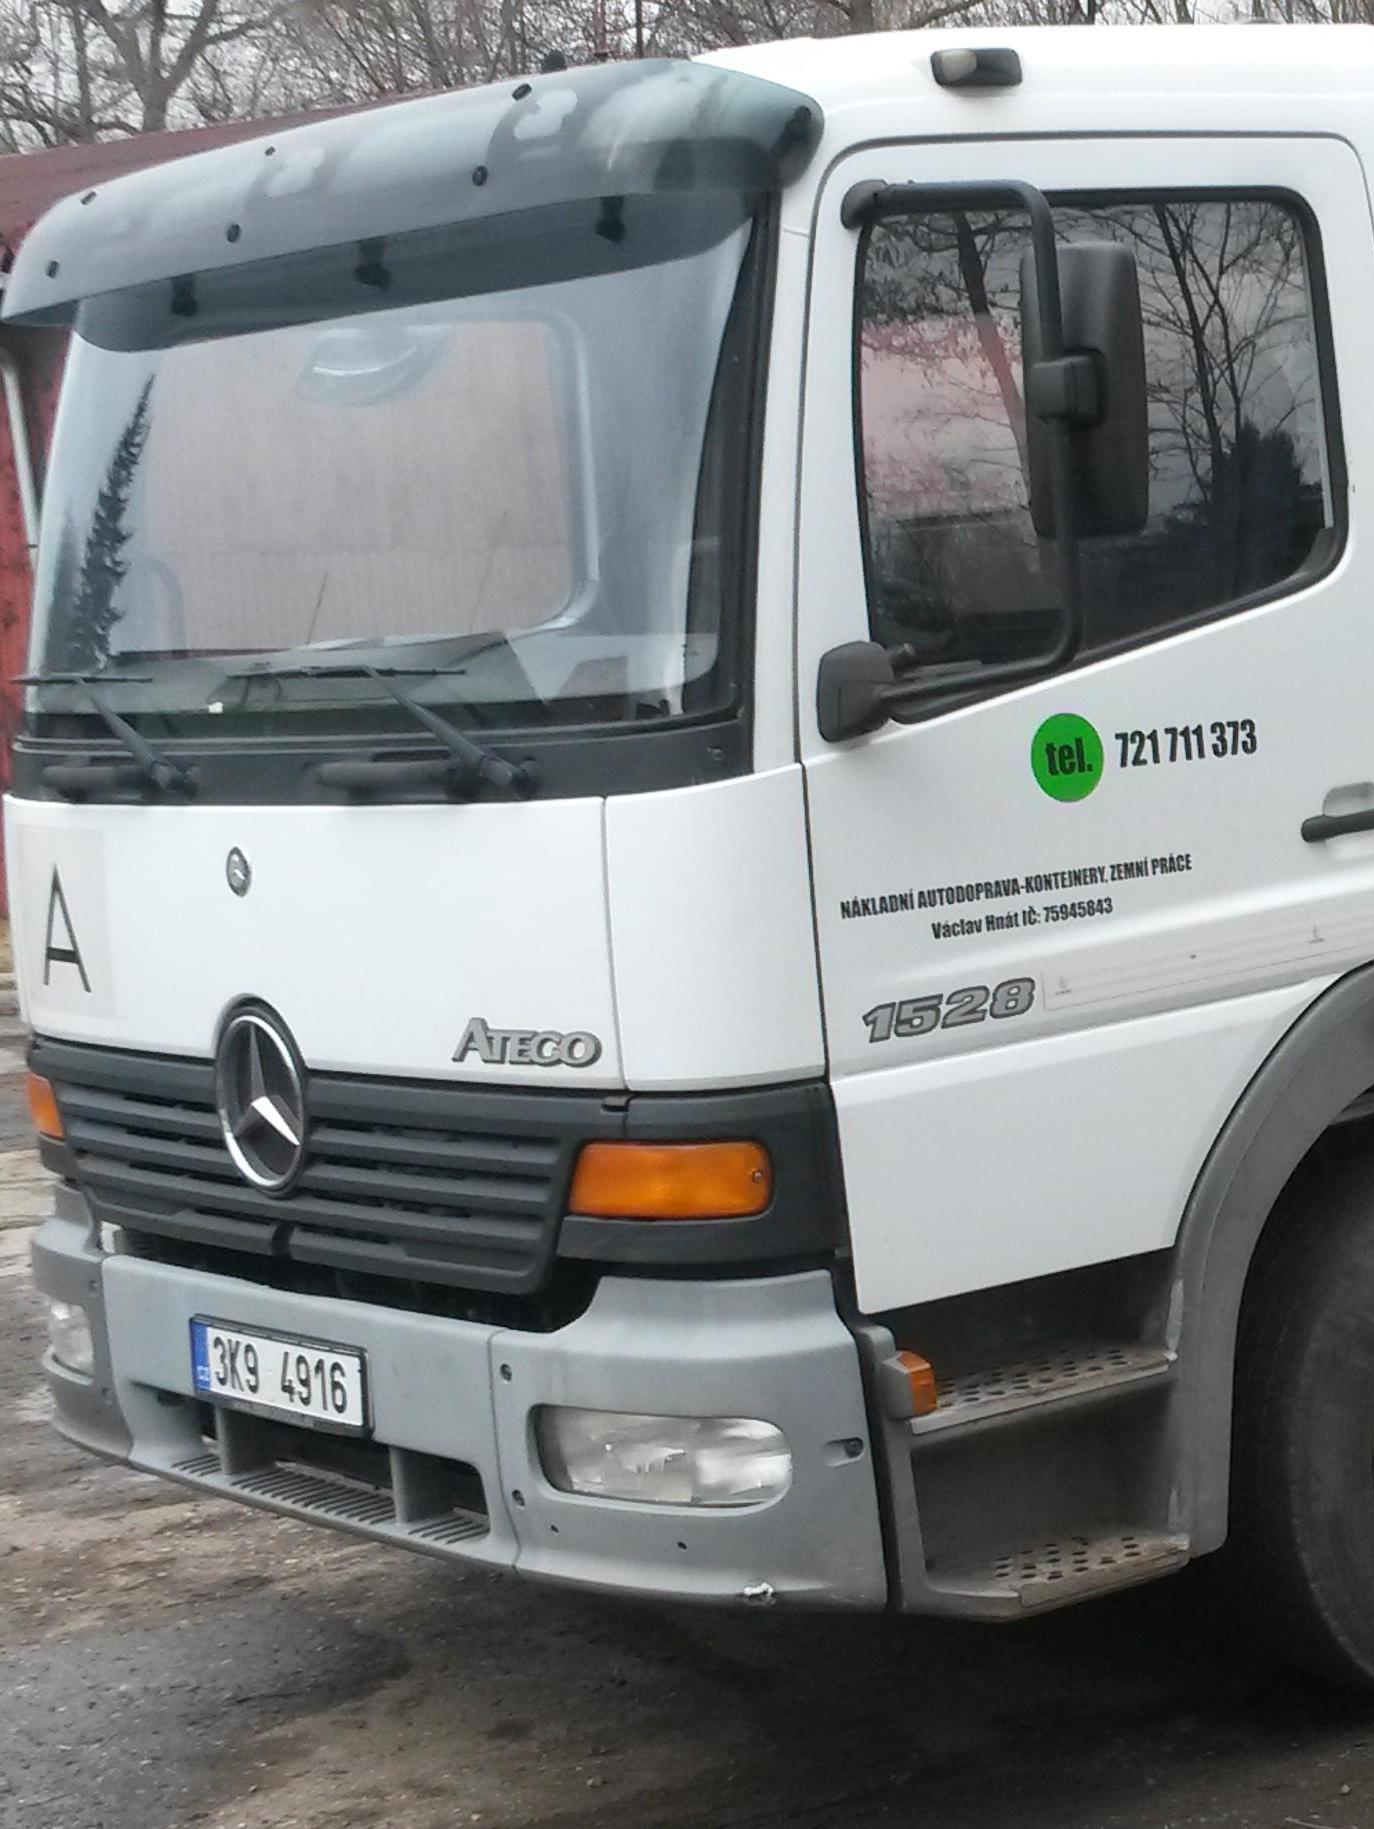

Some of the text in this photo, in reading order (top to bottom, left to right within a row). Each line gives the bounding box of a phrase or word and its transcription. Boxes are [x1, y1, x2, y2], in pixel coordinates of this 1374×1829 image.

[1045, 719, 1257, 775] tel. 721 711 373
[840, 889, 915, 919] NÁKLADNÍ
[1110, 857, 1149, 882] ZEMNÍ
[1151, 853, 1192, 876] PRÁCE
[931, 917, 982, 939] Václav
[1043, 897, 1114, 923] 75945843
[44, 864, 92, 994] A
[862, 977, 1036, 1044] 1528
[213, 1336, 347, 1414] 3K9 4916
